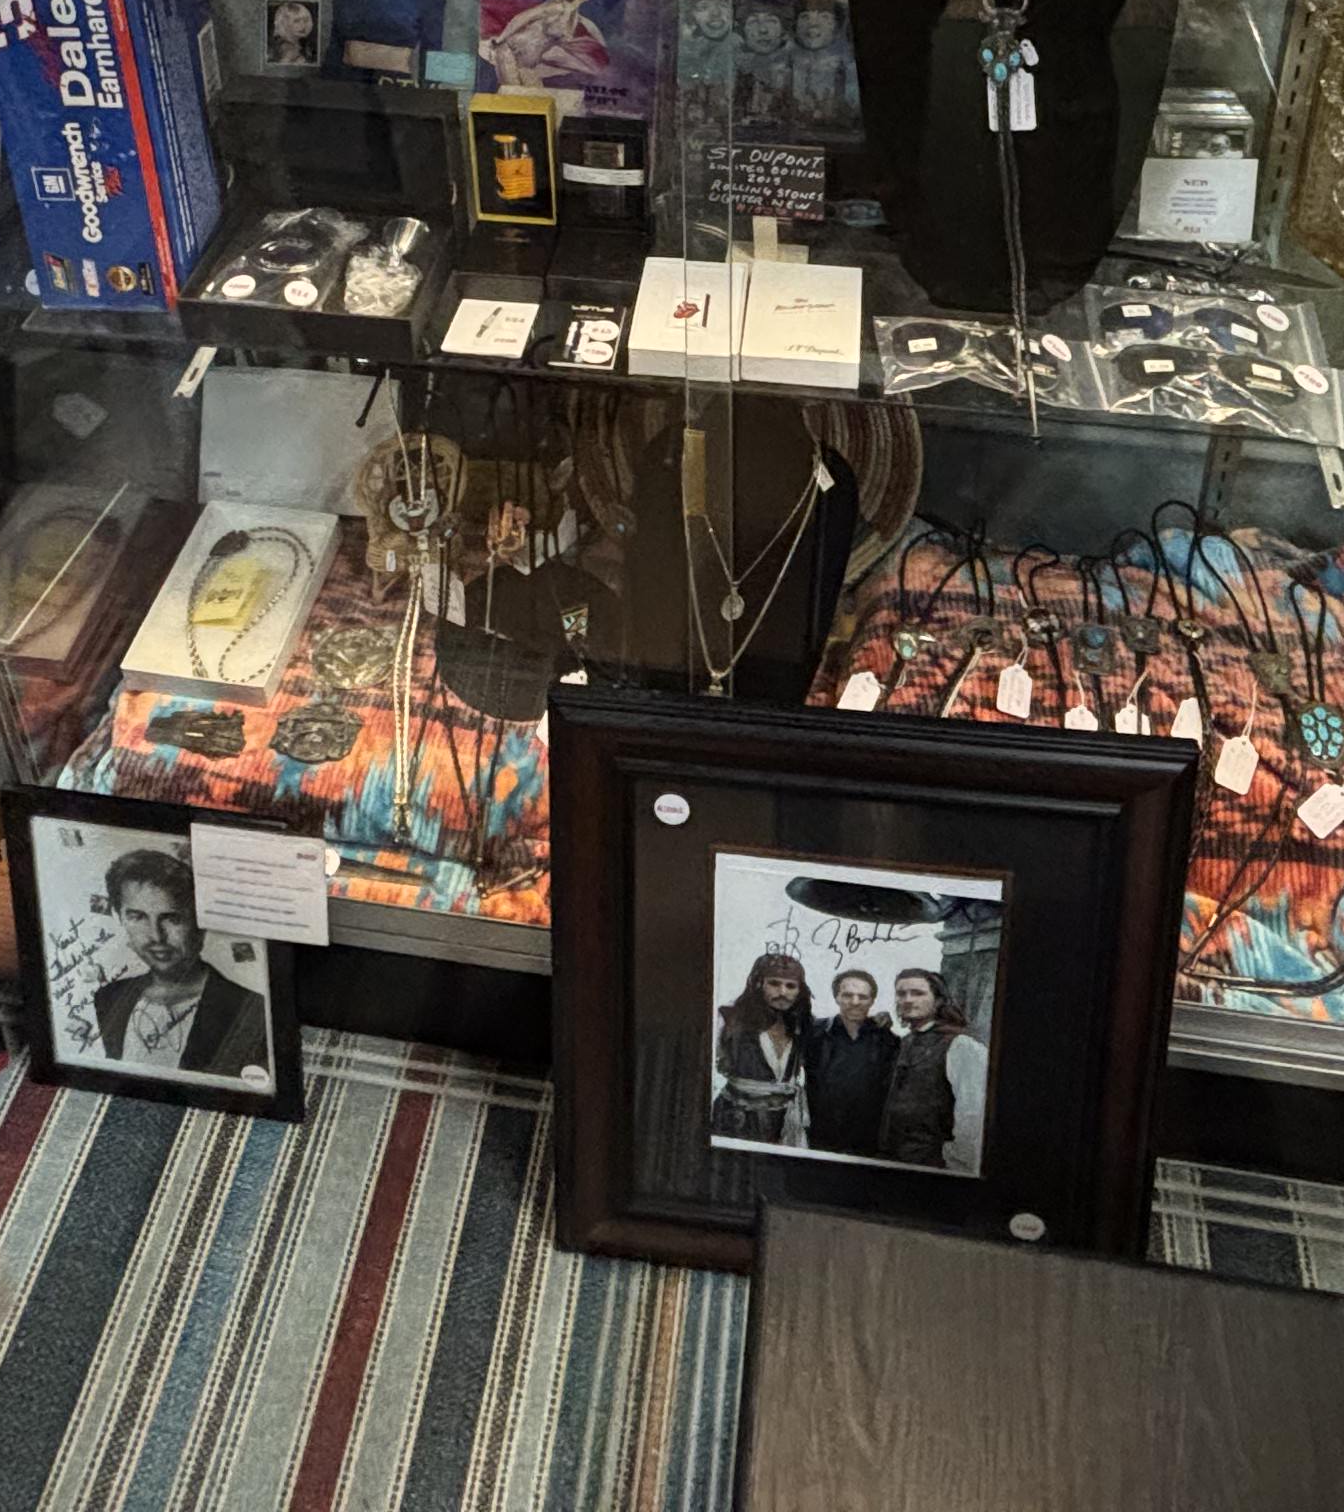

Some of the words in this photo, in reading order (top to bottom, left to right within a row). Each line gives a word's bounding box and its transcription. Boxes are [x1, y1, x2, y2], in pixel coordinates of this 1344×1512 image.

[749, 149, 825, 169] DUPONT
[60, 122, 104, 244] Goodwrench
[711, 178, 773, 197] ROLLING
[776, 187, 825, 202] STONES
[770, 198, 812, 210] NEW
